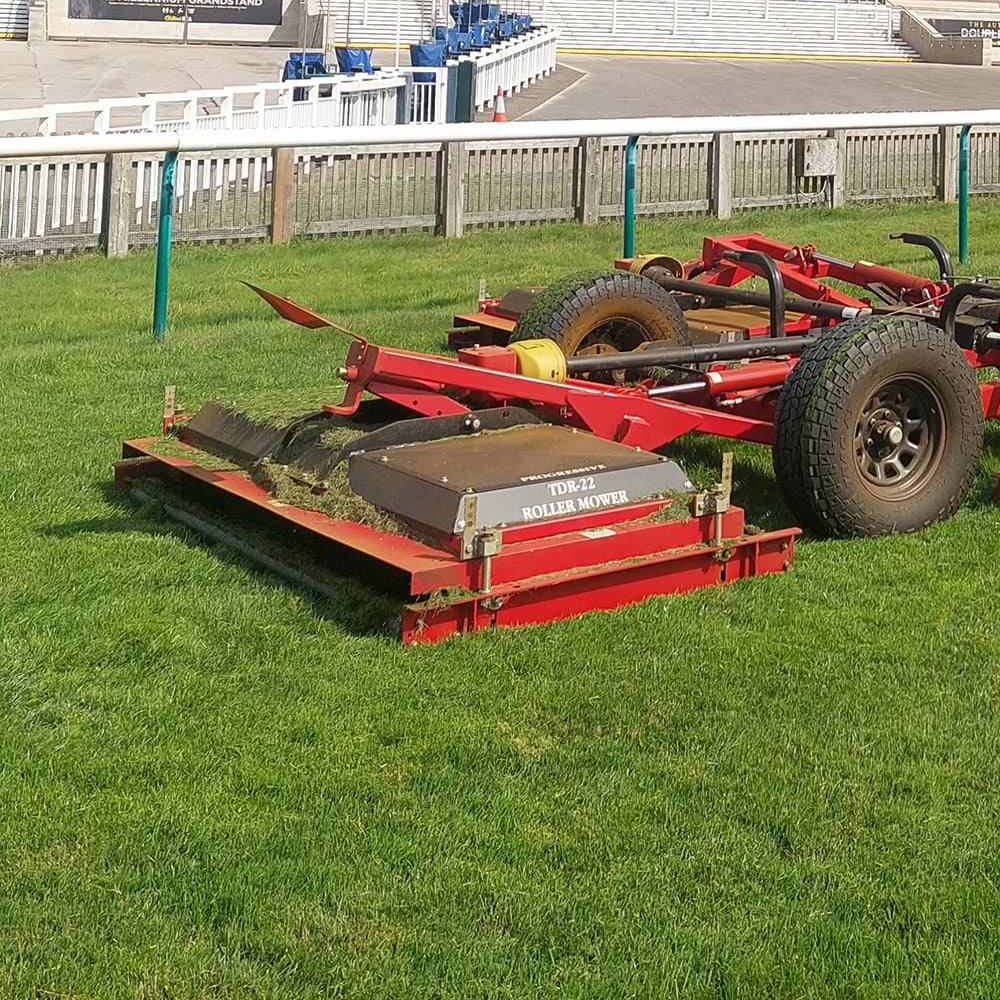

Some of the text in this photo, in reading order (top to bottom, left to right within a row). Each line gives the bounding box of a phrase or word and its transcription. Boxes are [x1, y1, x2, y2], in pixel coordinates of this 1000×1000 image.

[520, 464, 607, 482] PROGRESSIVE
[547, 477, 596, 497] TDR-22
[521, 490, 630, 520] ROLLER MOWER
